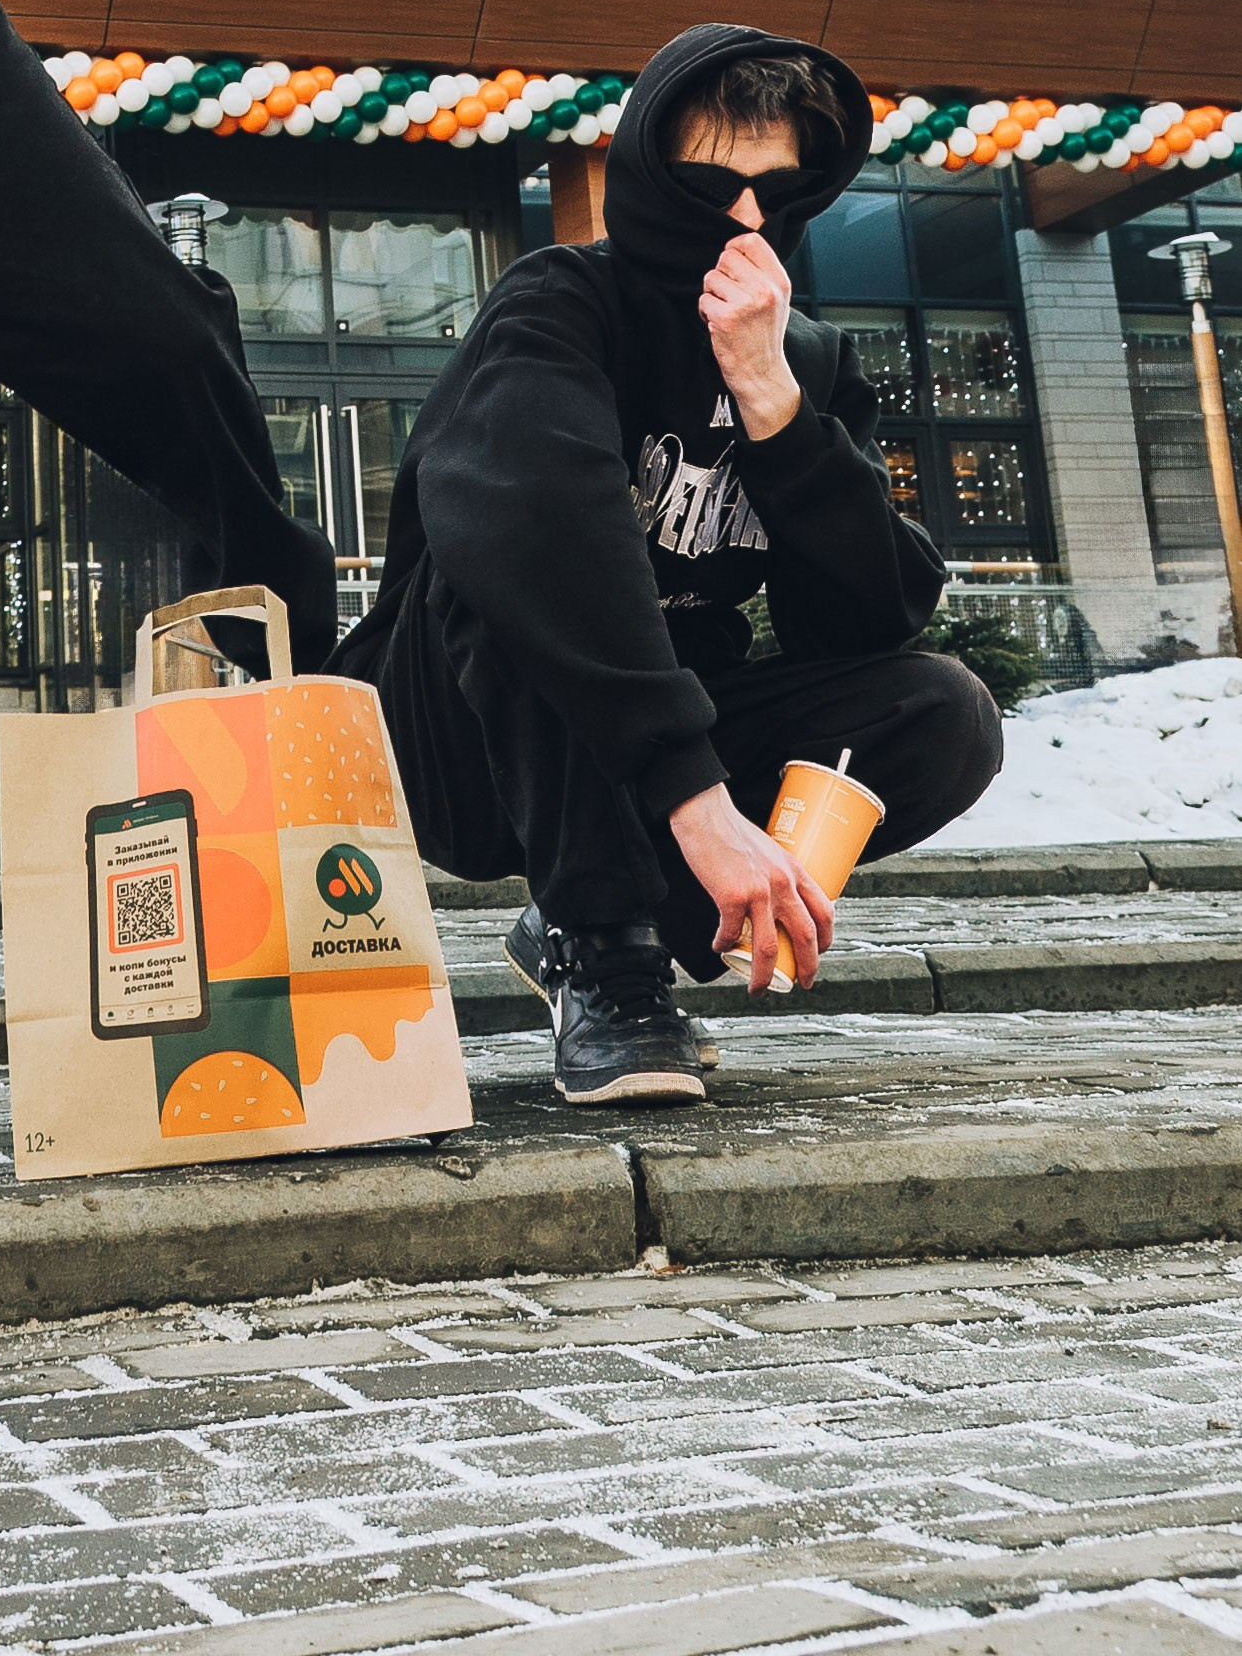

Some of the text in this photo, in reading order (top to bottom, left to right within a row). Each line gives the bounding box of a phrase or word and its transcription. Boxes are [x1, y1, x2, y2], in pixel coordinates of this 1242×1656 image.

[114, 835, 170, 855] Заказывай
[115, 846, 178, 866] приложении
[311, 937, 403, 958] ДОСТАВКА
[109, 954, 187, 973] и копи бонусы
[124, 966, 173, 982] с каждой
[124, 980, 174, 996] доставки
[25, 1131, 55, 1153] 12+
